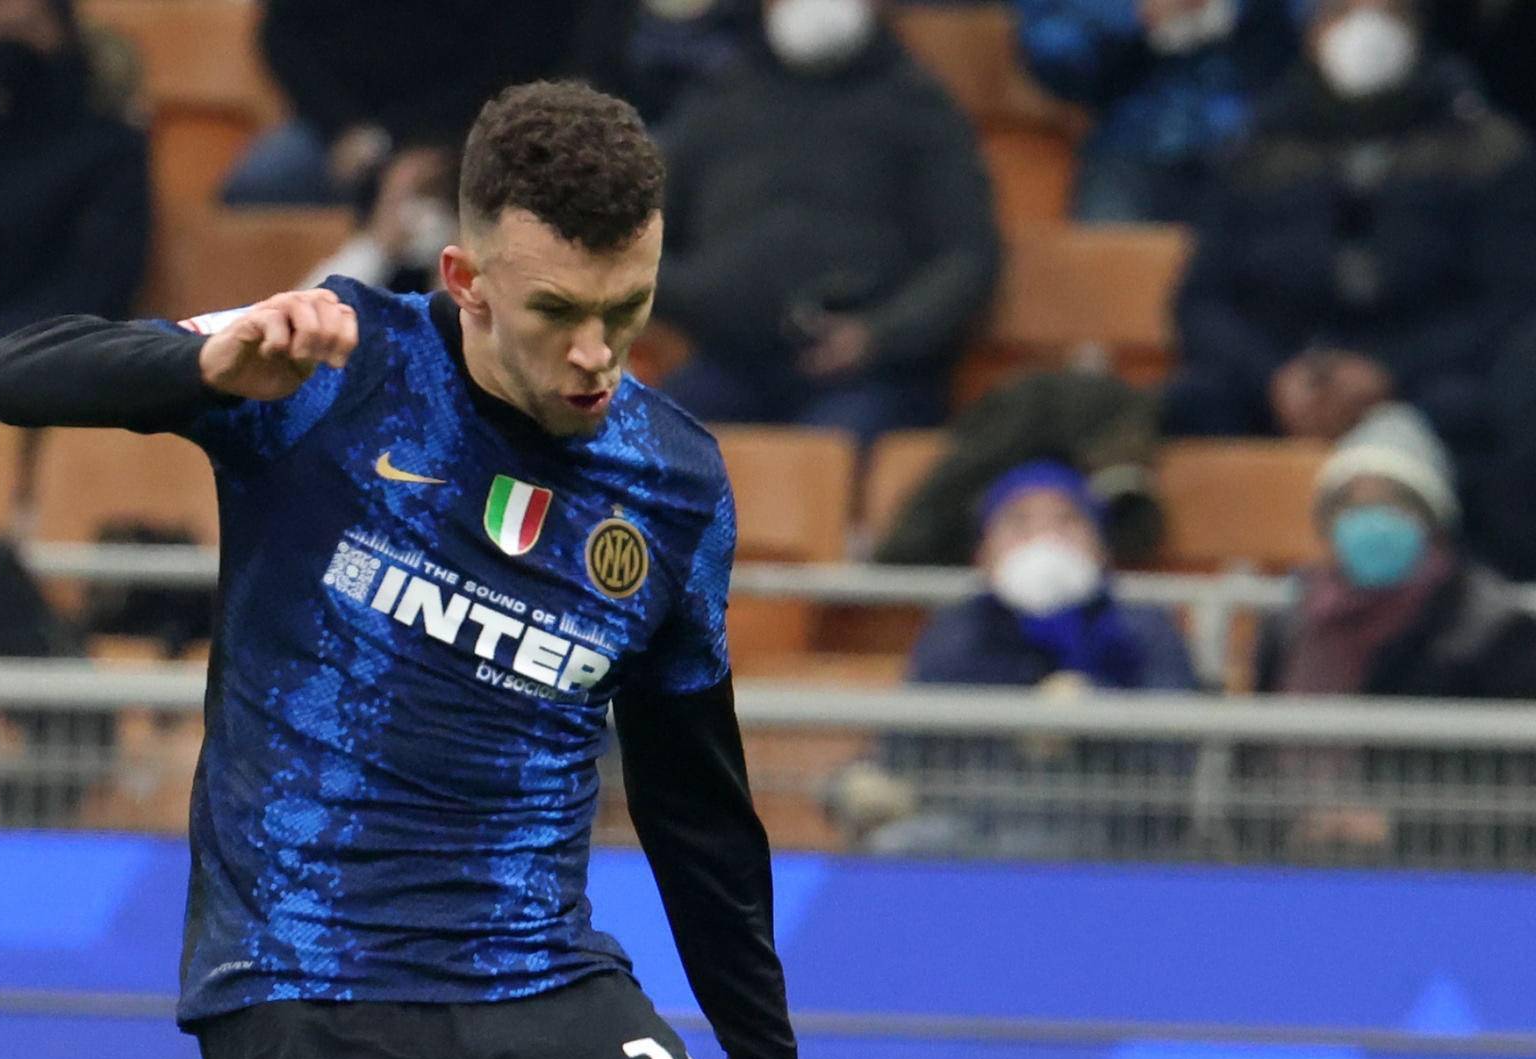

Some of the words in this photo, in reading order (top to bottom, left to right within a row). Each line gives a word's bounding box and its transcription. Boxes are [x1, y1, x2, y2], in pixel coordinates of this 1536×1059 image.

[370, 565, 612, 692] INTER
[423, 561, 460, 585] THE
[464, 580, 528, 614] SOUND
[531, 609, 557, 626] OF
